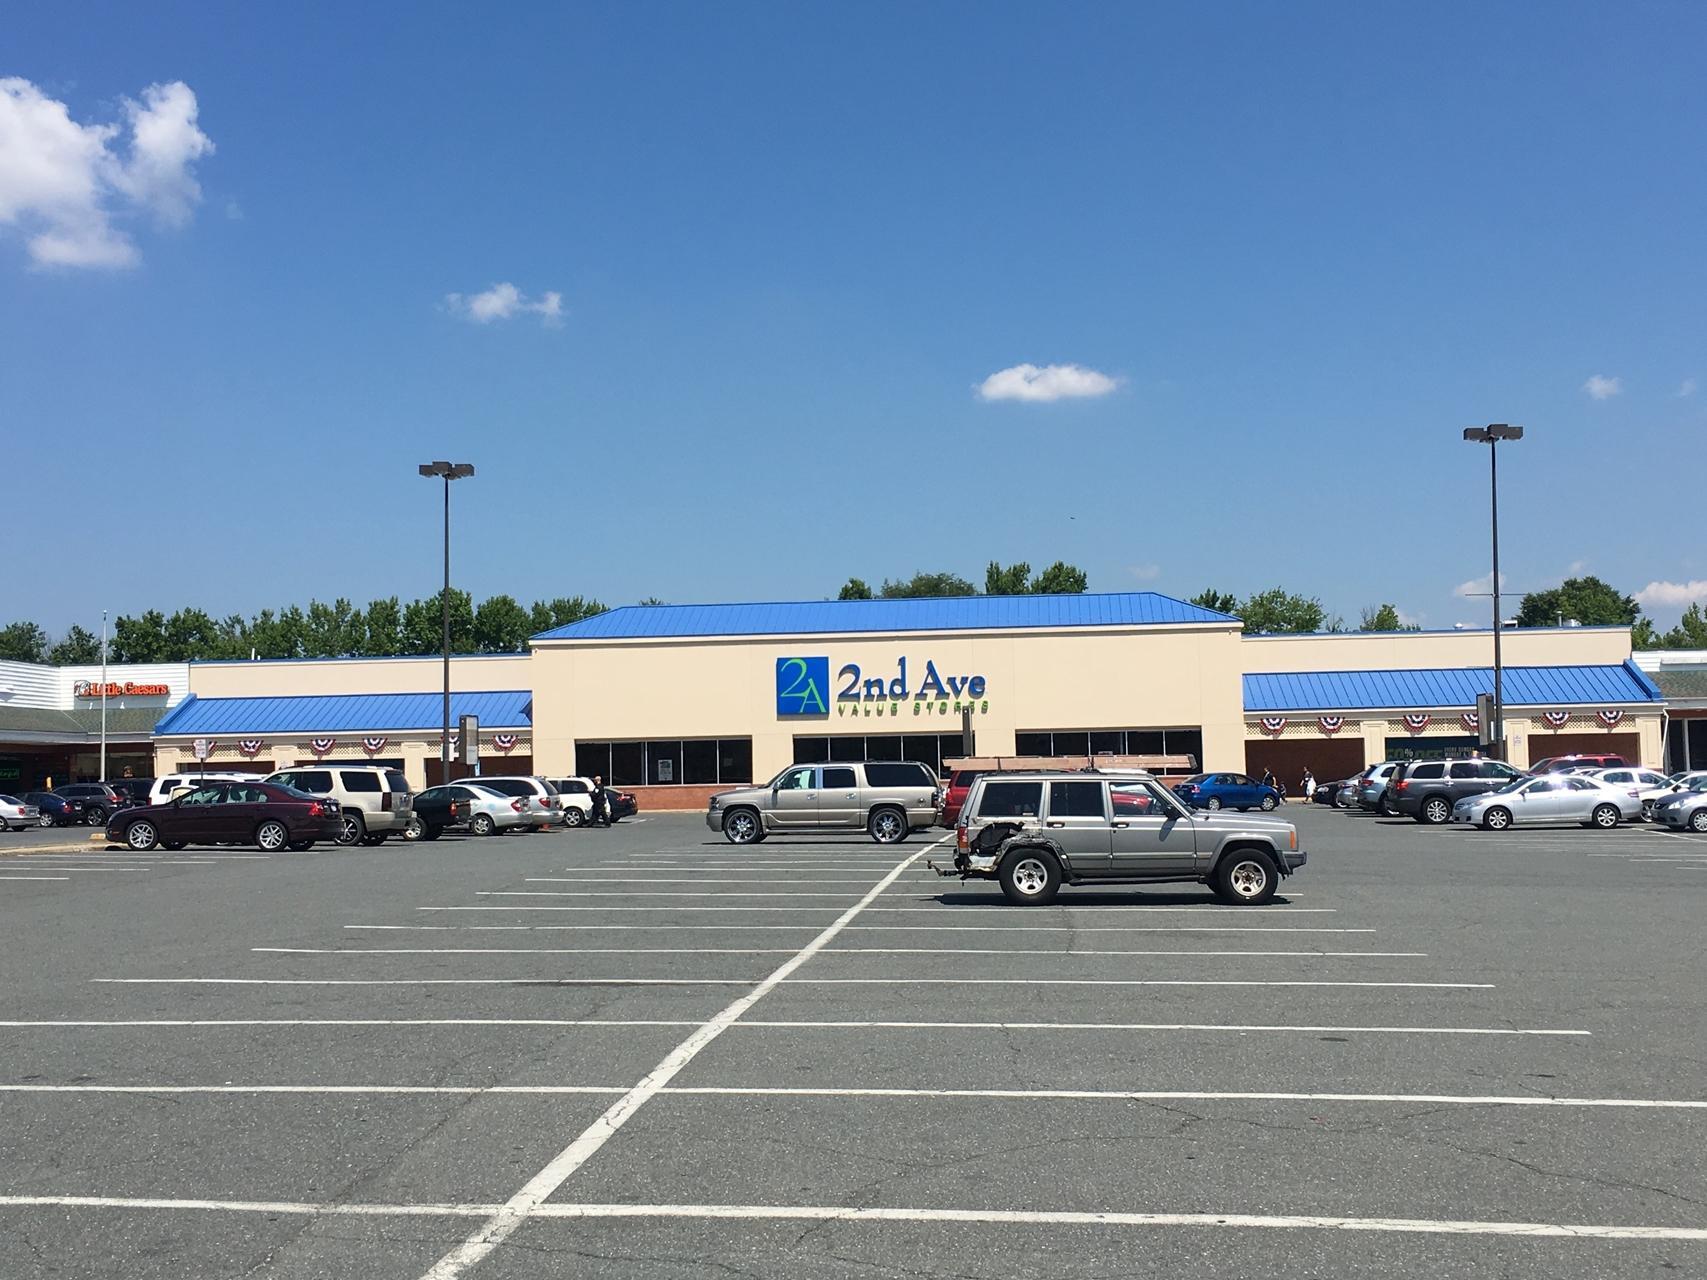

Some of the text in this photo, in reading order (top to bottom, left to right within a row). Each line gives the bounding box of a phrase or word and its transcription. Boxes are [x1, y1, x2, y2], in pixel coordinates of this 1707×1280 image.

[837, 656, 987, 702] 2nd Ave
[90, 682, 168, 696] Litle Caesars
[837, 700, 988, 717] VALUE STORES
